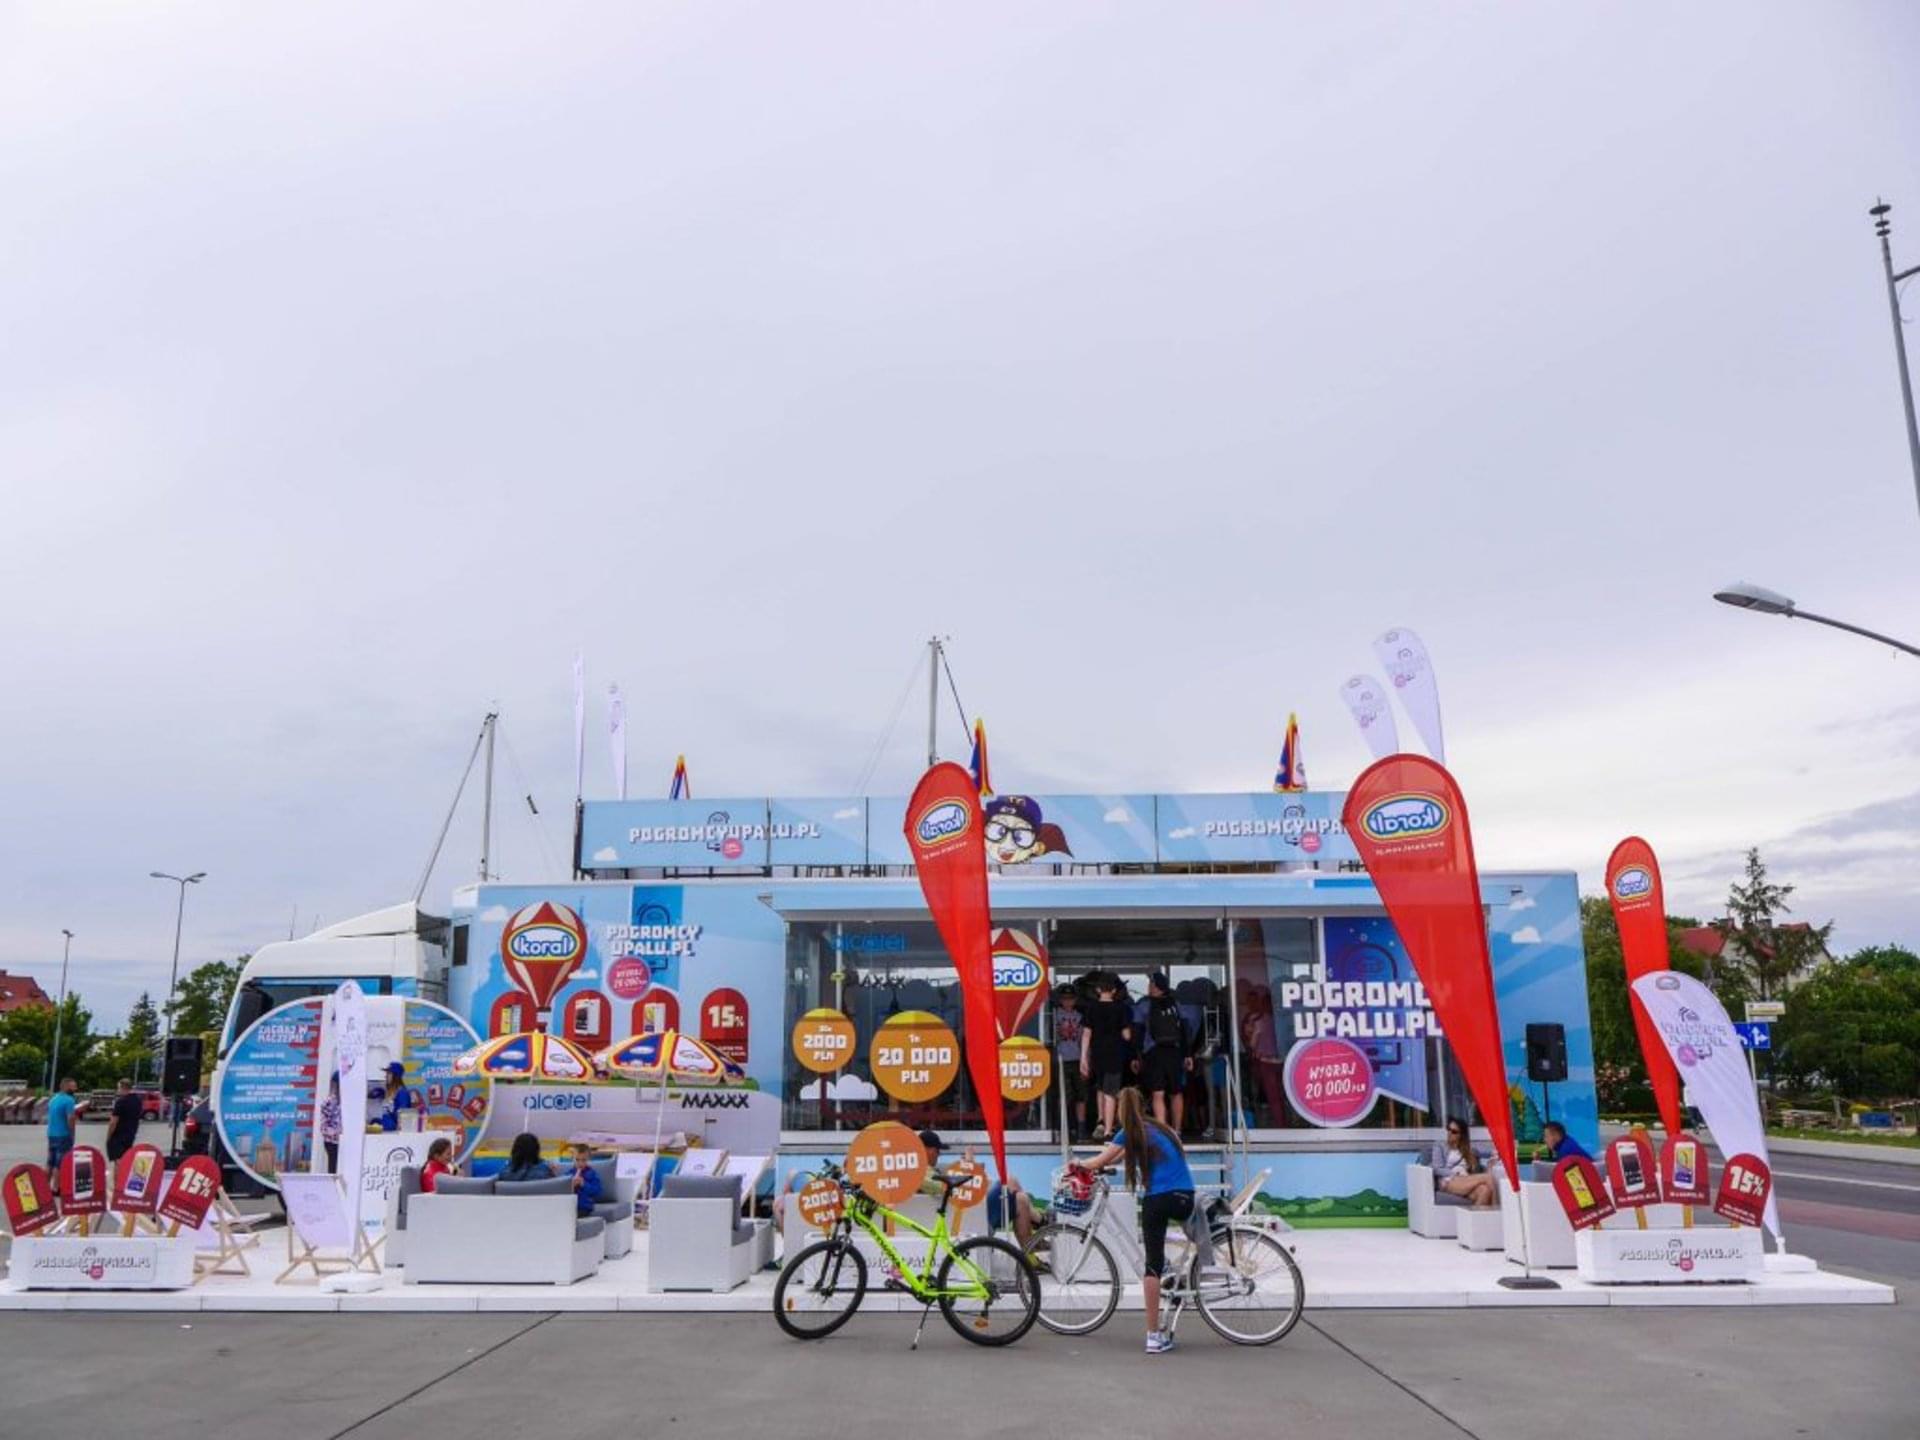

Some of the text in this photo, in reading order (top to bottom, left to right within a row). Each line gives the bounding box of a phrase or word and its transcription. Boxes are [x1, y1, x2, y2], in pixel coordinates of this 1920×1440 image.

[1204, 817, 1344, 838] POGROMCYUPA
[606, 925, 701, 940] POGROMCY
[518, 934, 570, 956] koral
[611, 941, 695, 956] UPALU.PL
[992, 965, 1032, 984] oral
[708, 1005, 743, 1028] 15%
[1293, 1011, 1443, 1038] UPALU.PL
[803, 1034, 847, 1049] 2000
[878, 1046, 952, 1065] 20 000
[900, 1069, 930, 1084] PLN
[1305, 1083, 1322, 1099] 20
[1325, 1079, 1351, 1096] 000
[523, 1092, 591, 1110] alcatel
[681, 1092, 749, 1109] MAXXX
[855, 1152, 919, 1173] 20 000
[179, 1167, 214, 1198] 15%
[876, 1177, 900, 1190] PLN
[1729, 1165, 1765, 1196] 15%
[802, 1190, 839, 1210] 2000
